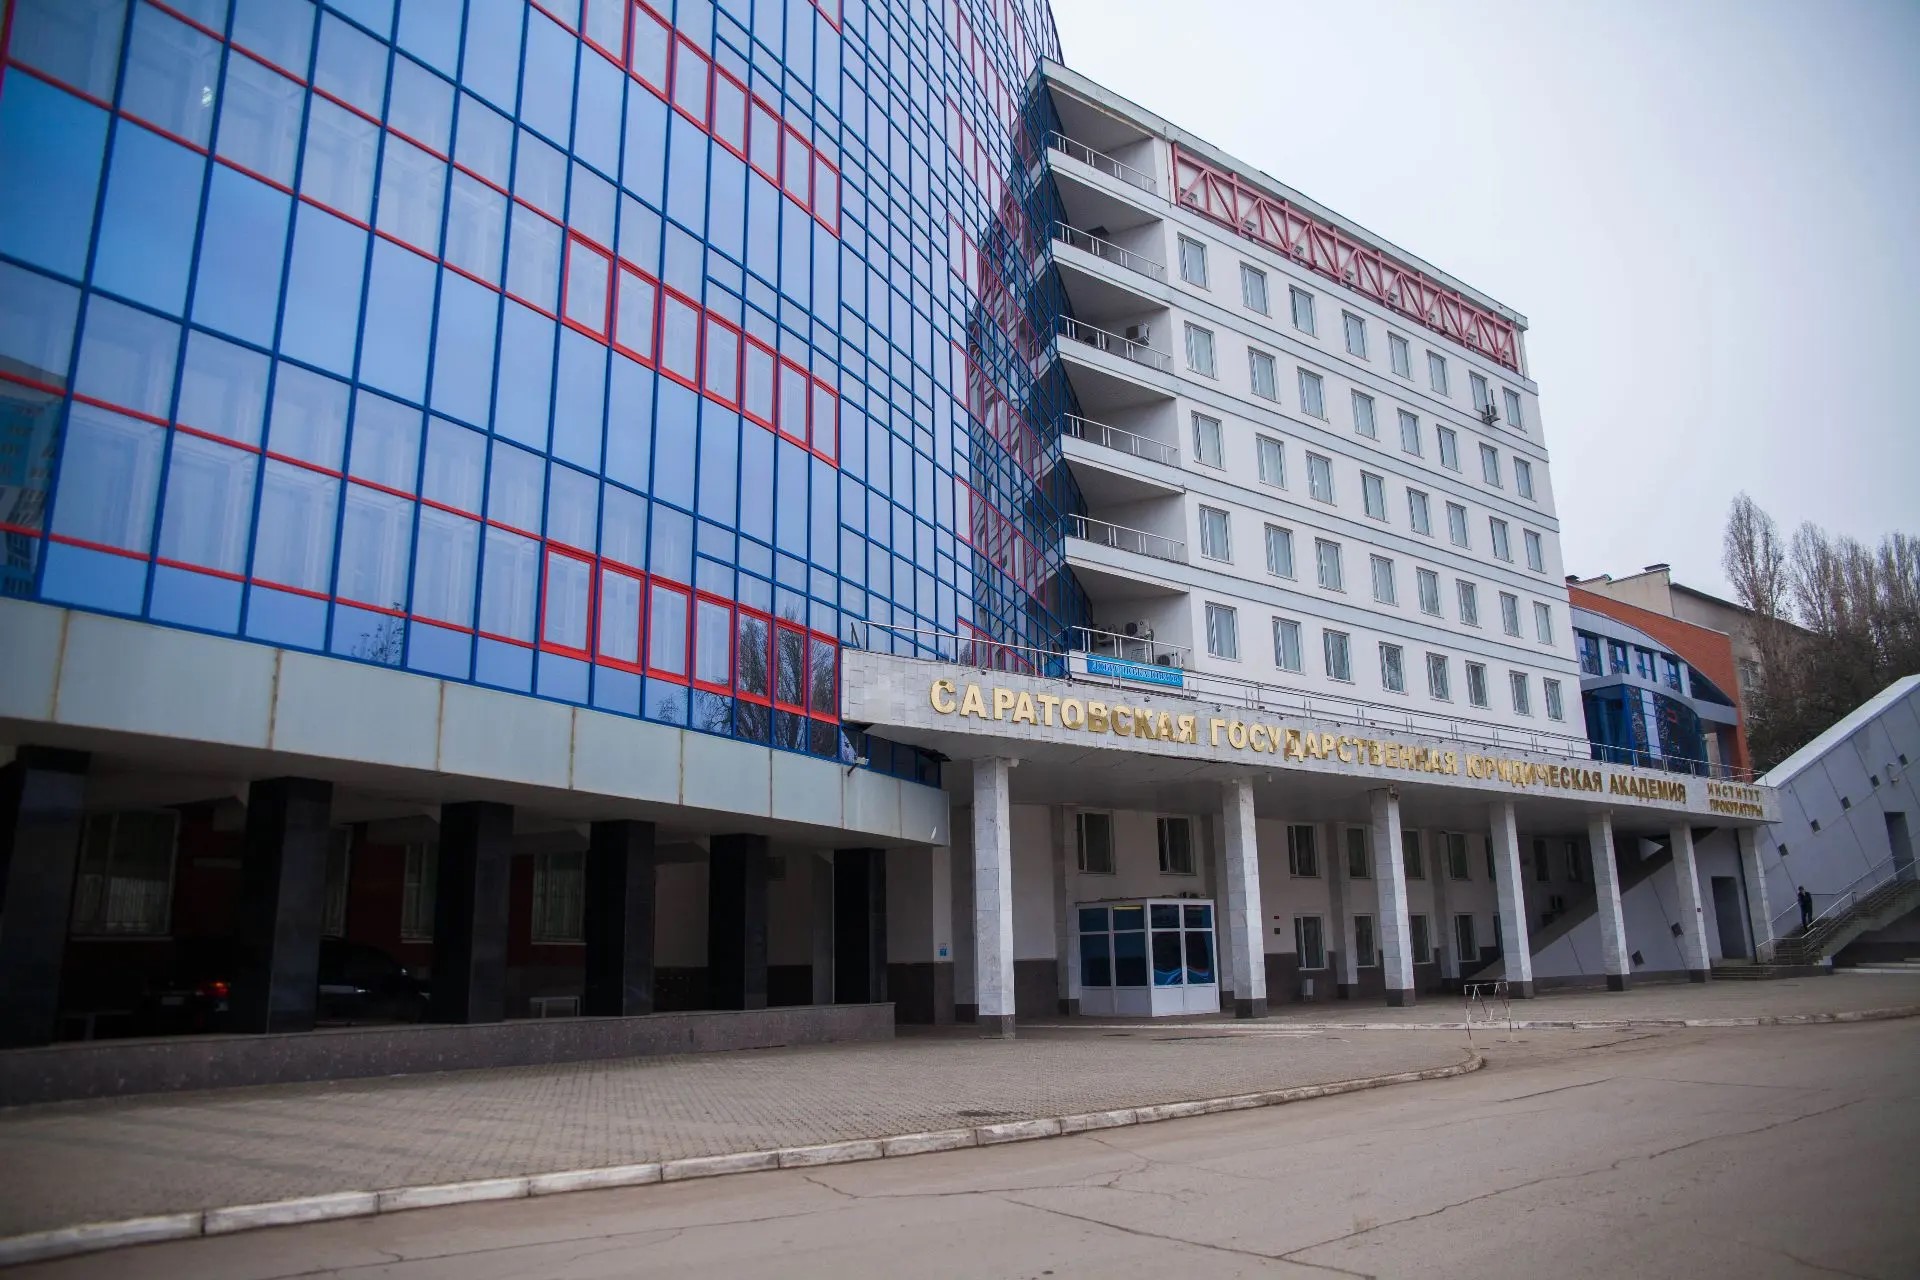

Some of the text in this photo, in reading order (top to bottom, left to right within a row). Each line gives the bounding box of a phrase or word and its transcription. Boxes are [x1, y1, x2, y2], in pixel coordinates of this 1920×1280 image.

[930, 679, 1687, 803] САРАТОВСКАЯ ГОСУДАРСТВЕННАЯ ЮРИДИЧЕСКАЯ АКАДЕМИЯ
[1706, 782, 1760, 802] ИНСТИТУТ
[1709, 798, 1764, 818] ПРОКУРАТУРЫ
